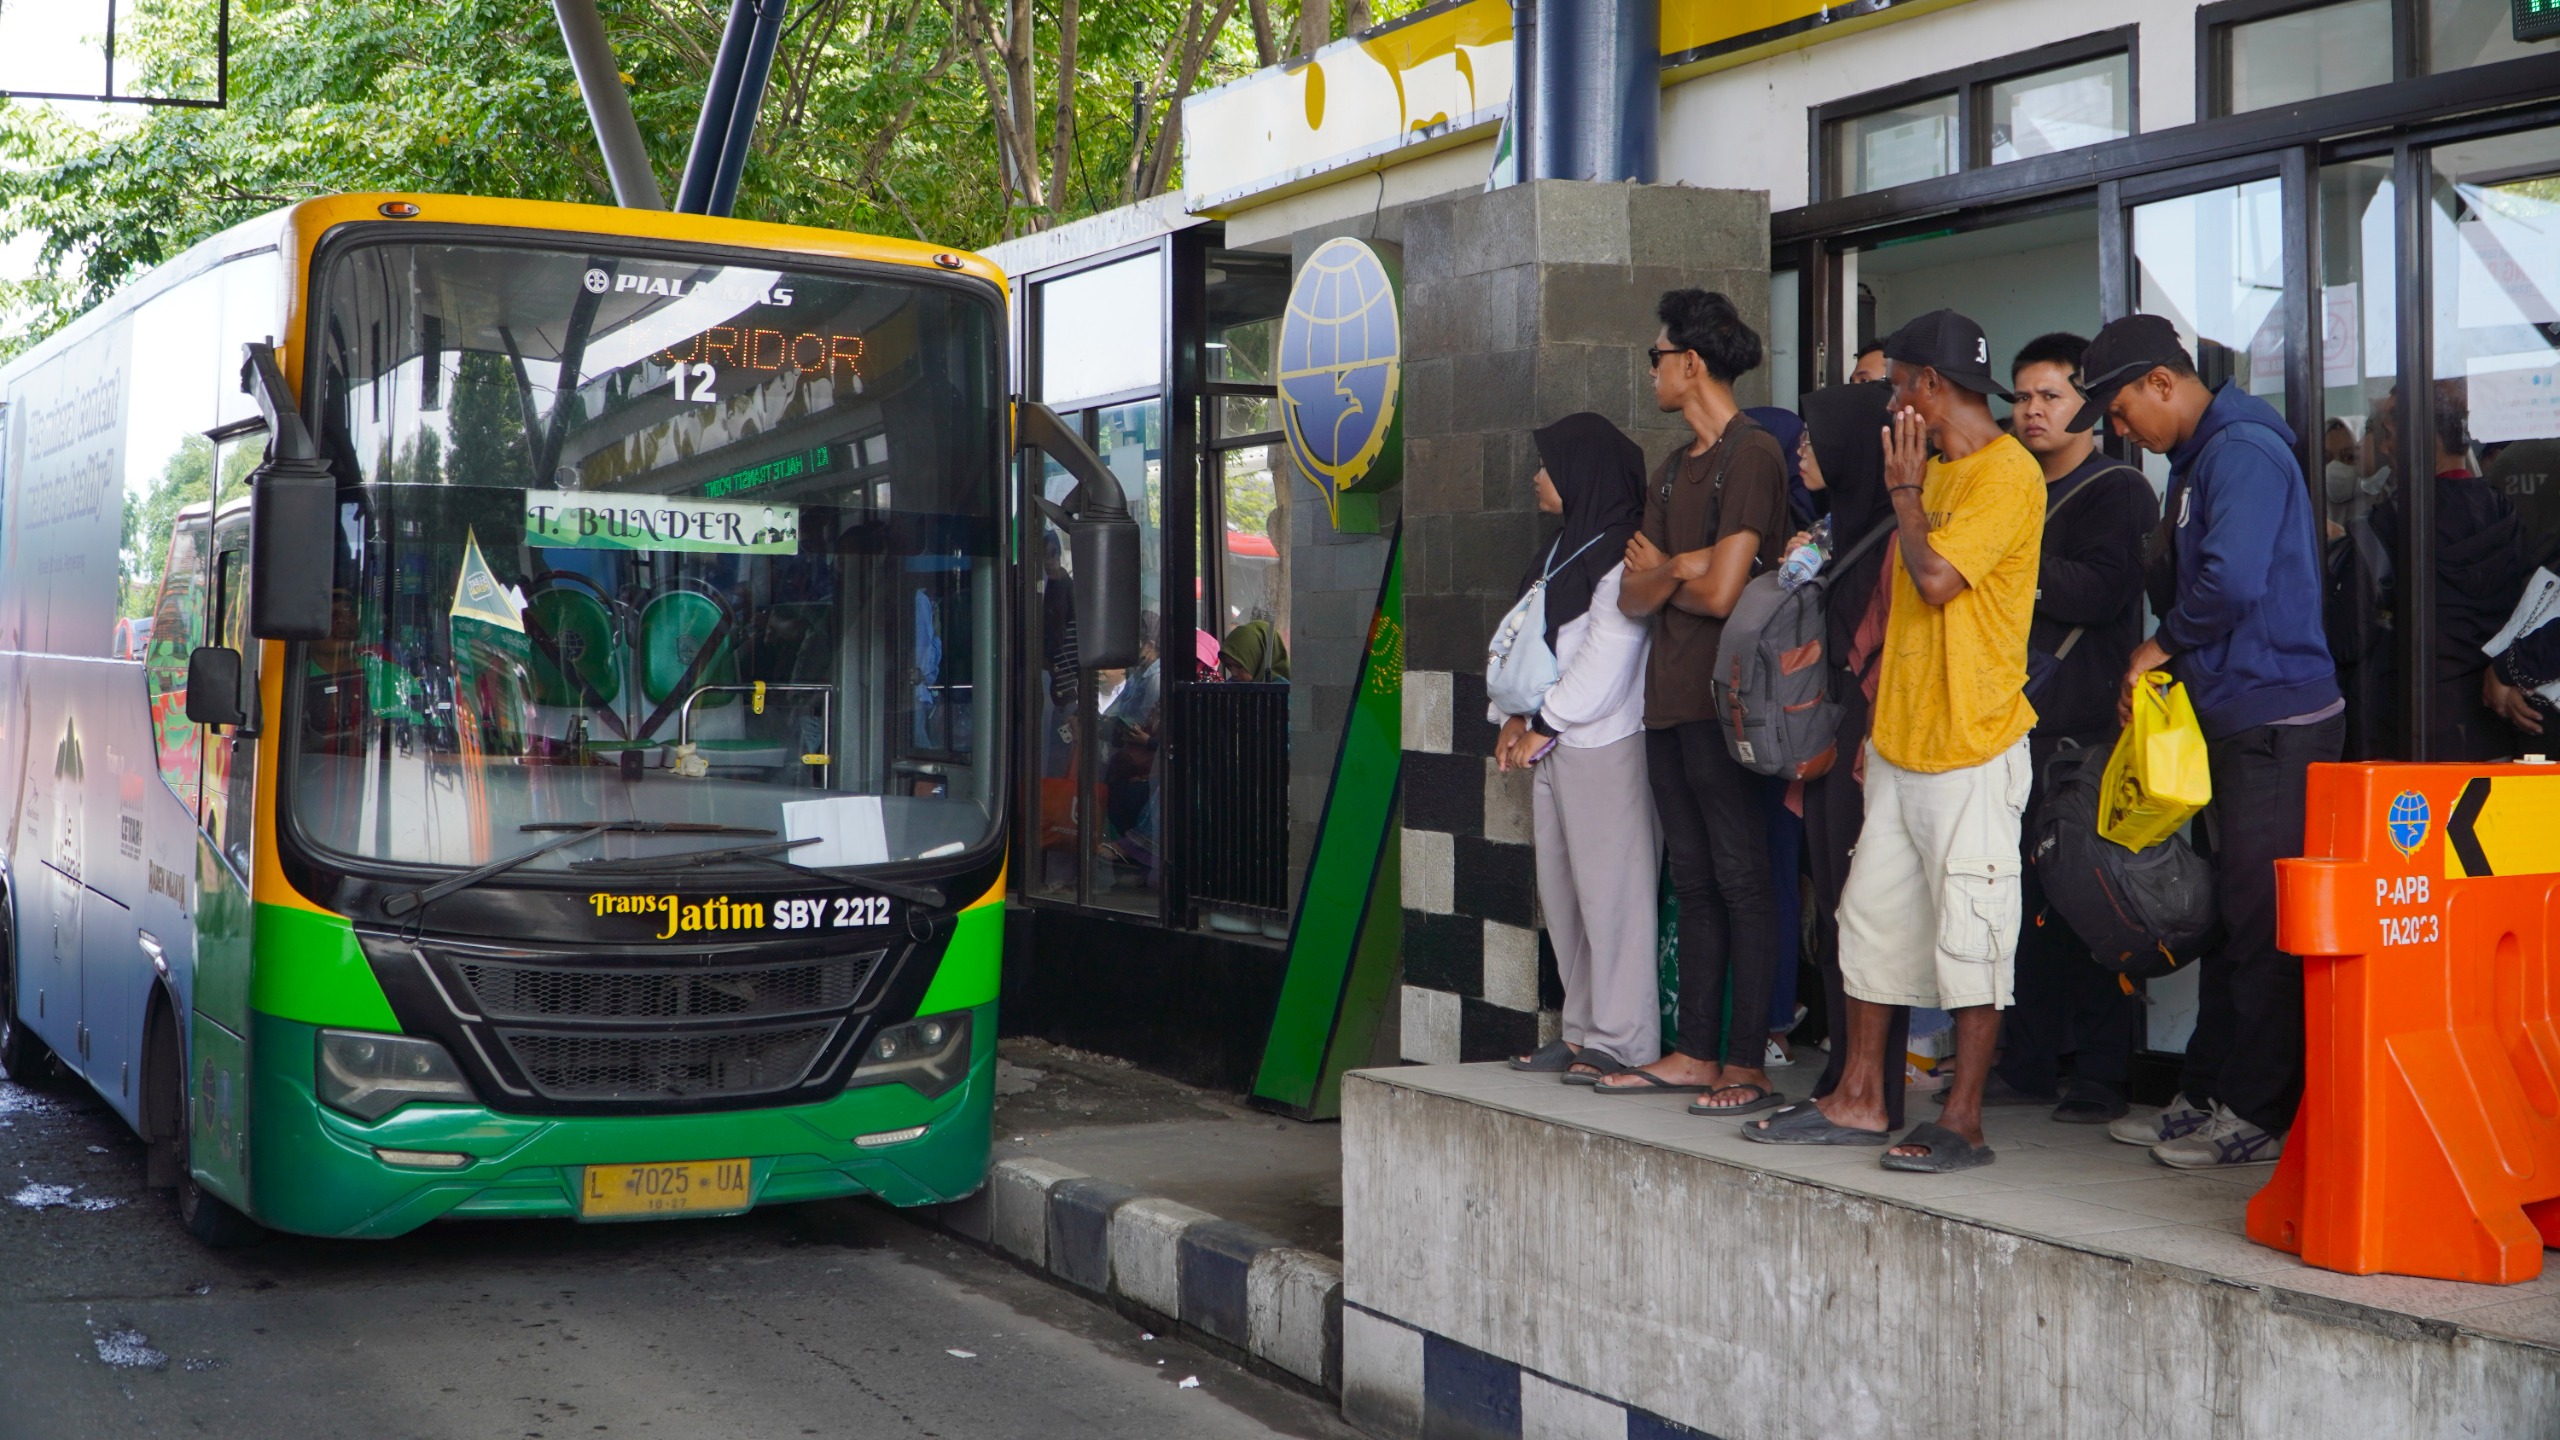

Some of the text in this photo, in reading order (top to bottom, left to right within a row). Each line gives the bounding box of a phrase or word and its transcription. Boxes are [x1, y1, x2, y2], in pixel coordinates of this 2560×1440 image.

[614, 273, 794, 307] PIALA MAS
[629, 319, 864, 376] KORIDOR
[666, 362, 717, 403] 12
[77, 366, 121, 443] content
[528, 505, 750, 547] T. BUNDER
[589, 893, 890, 940] Trans Jatim SBY 2212
[591, 1164, 744, 1199] L 7025 UA
